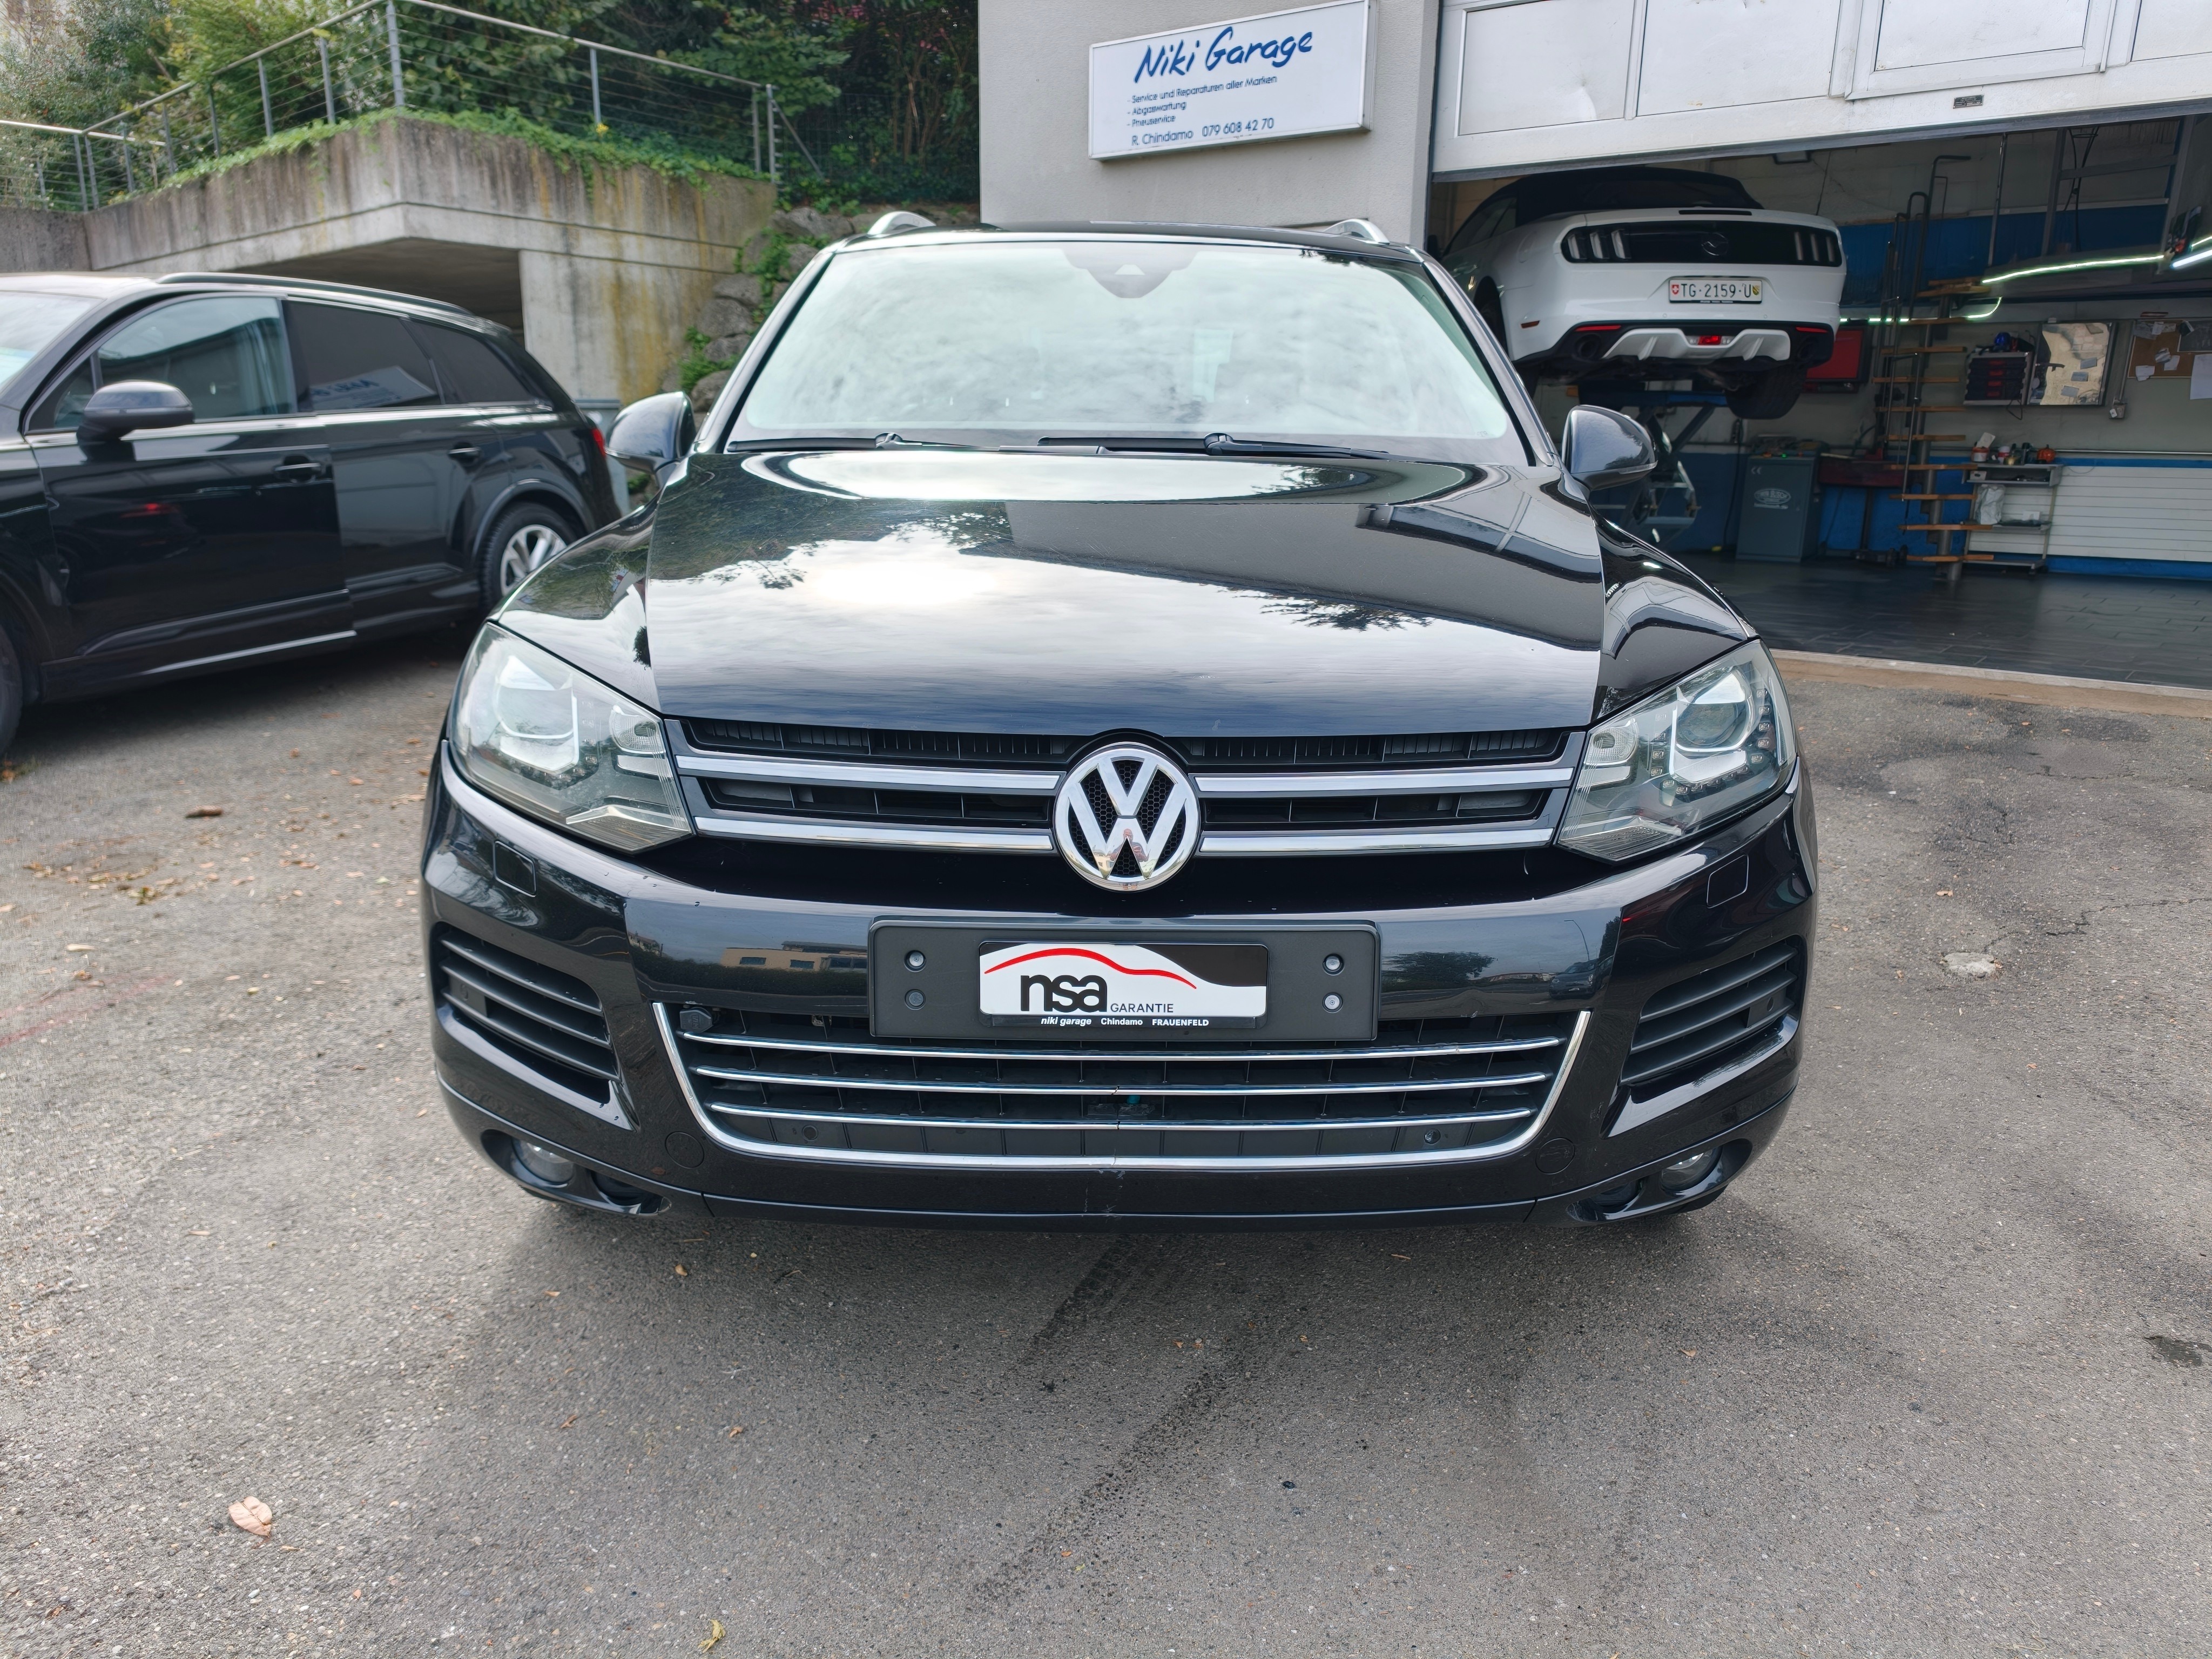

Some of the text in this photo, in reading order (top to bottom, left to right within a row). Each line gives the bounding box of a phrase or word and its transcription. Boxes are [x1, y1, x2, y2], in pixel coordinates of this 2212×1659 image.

[1134, 26, 1312, 83] Niki Garage
[1132, 76, 1278, 103] Service und Reparaturen aller Marken
[1131, 117, 1274, 146] R. Chindamo 079 608 42 70
[1058, 750, 1197, 887] VW
[1020, 974, 1174, 1013] nsa GARANTIE
[1041, 1016, 1058, 1025] niki
[1060, 1017, 1092, 1027] garage
[1101, 1017, 1143, 1026] Chindamo
